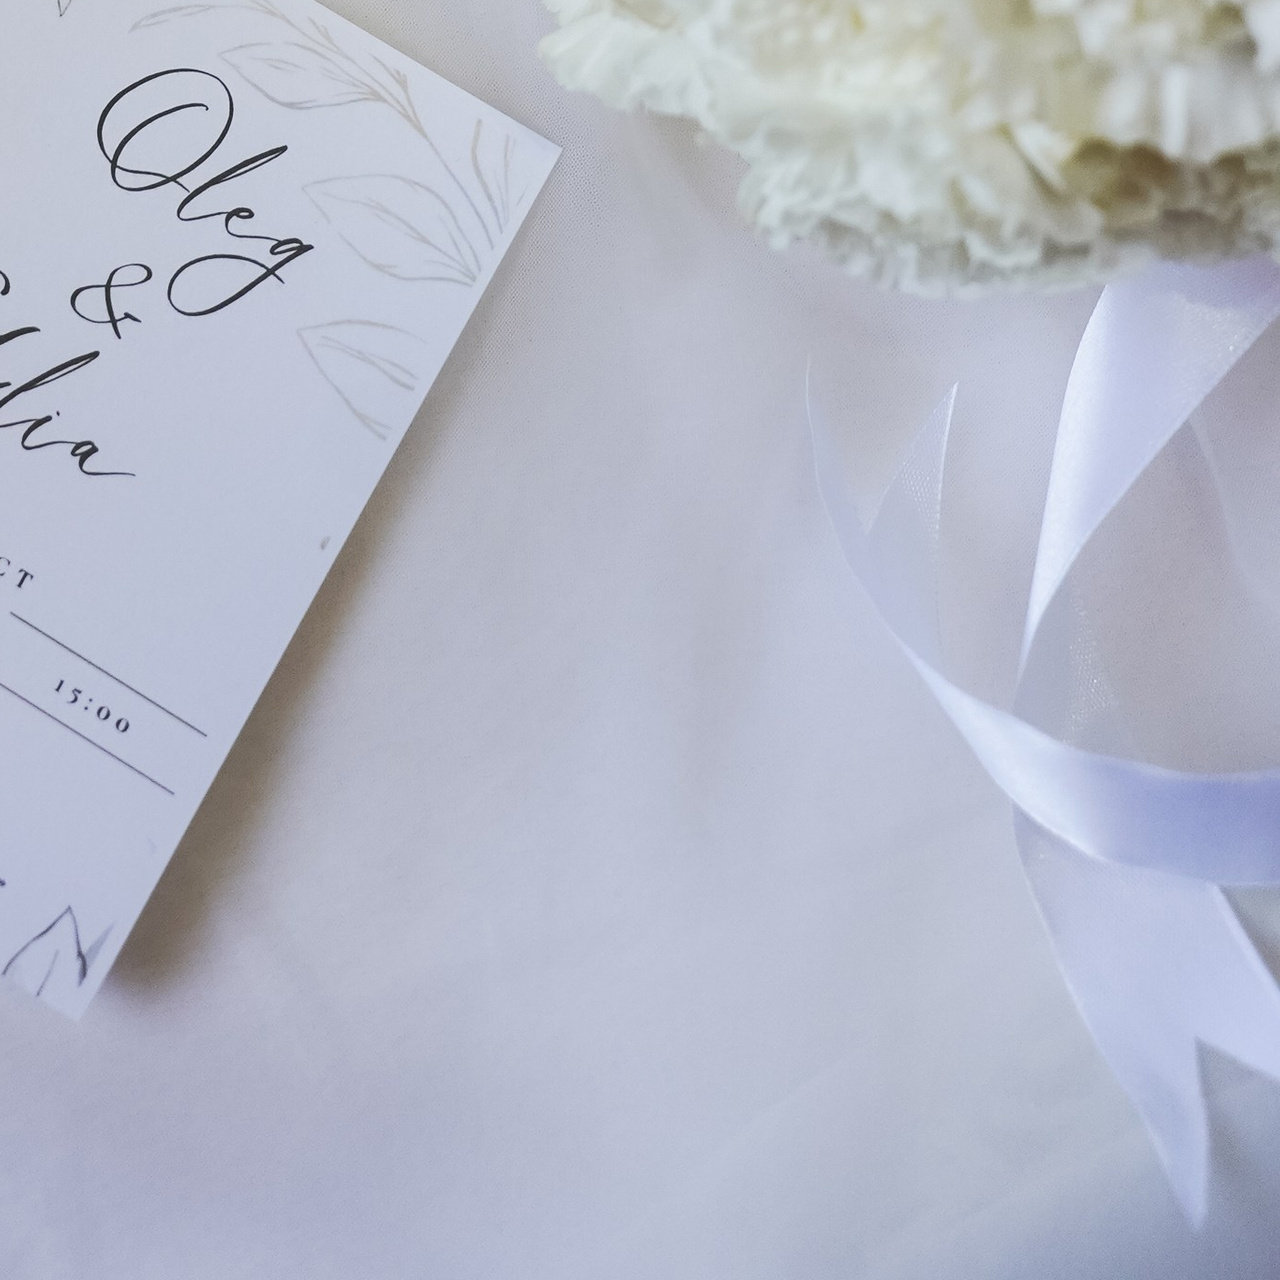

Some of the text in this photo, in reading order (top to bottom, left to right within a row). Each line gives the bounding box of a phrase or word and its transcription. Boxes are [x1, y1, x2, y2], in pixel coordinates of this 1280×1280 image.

[96, 67, 315, 317] Oleg
[69, 262, 154, 340] &
[54, 679, 131, 735] 15:00
